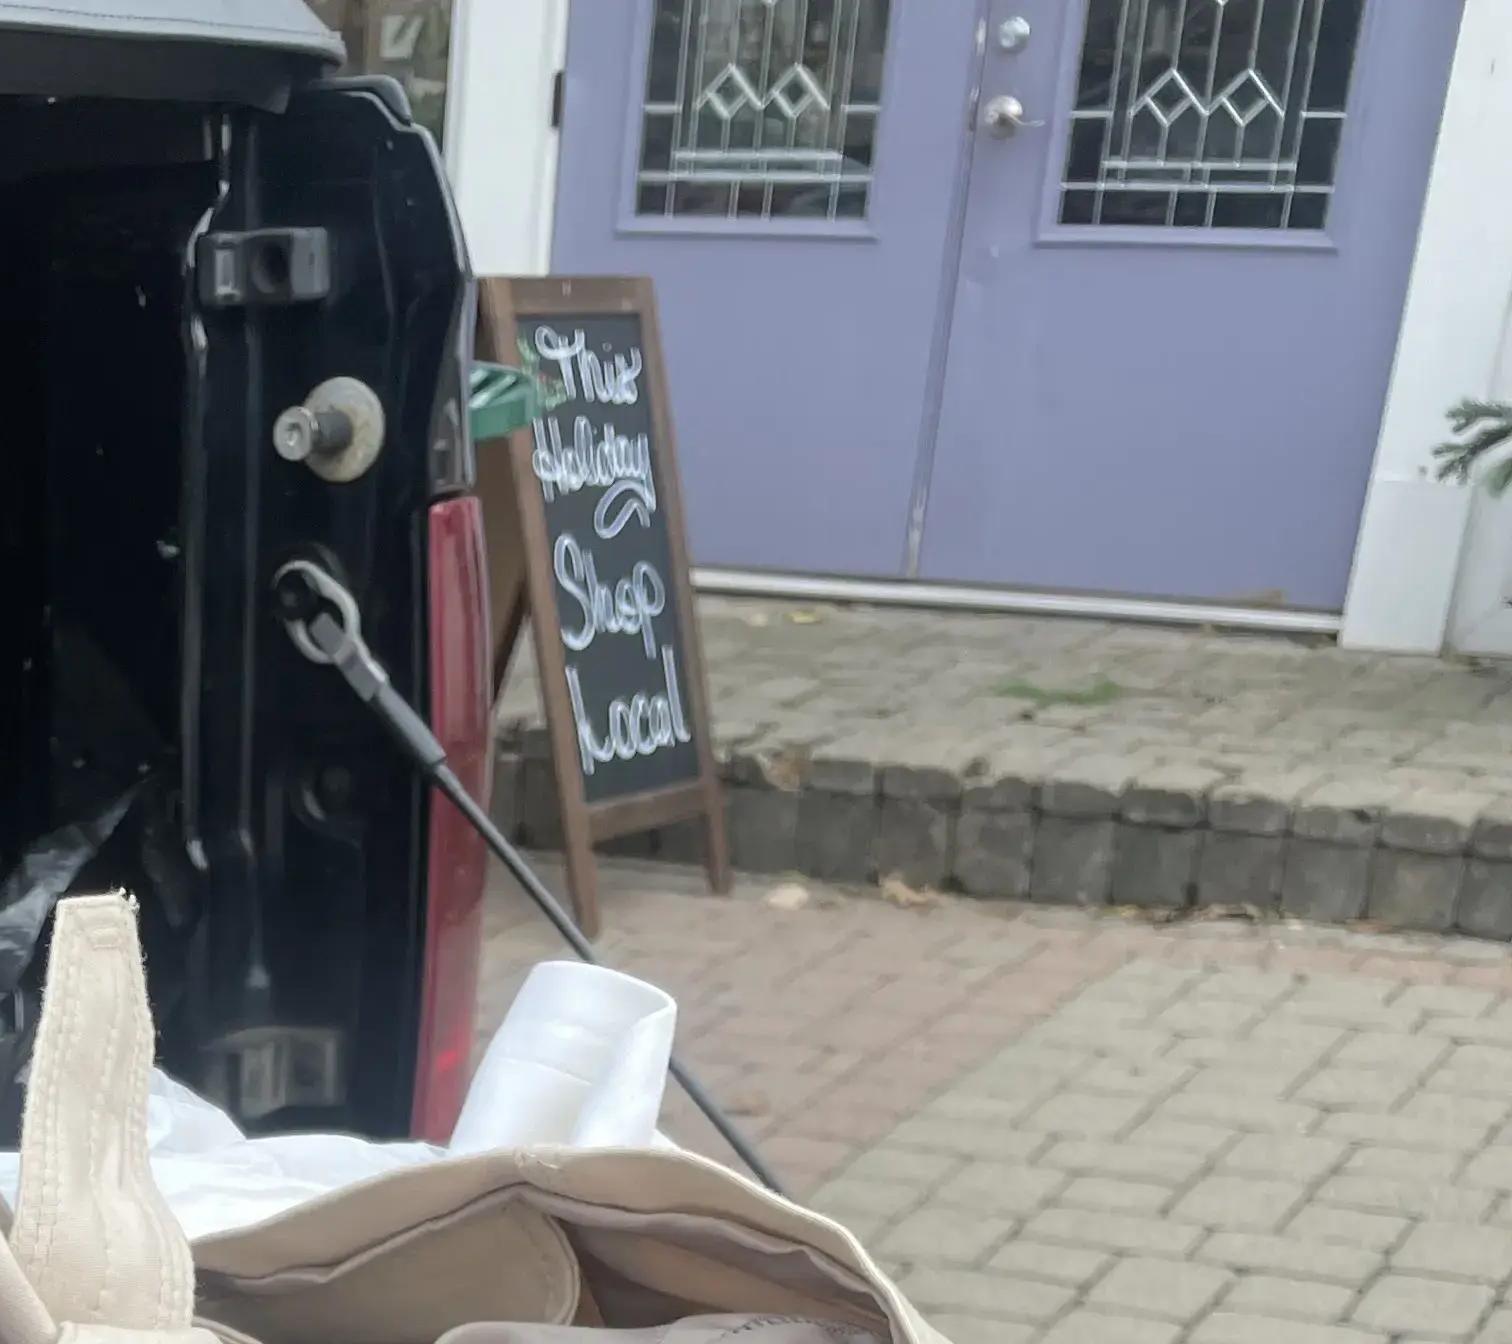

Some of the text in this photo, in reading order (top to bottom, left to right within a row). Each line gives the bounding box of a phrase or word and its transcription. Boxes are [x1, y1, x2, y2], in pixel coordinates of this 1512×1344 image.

[535, 324, 642, 404] This
[532, 415, 656, 539] Holiday
[554, 533, 665, 660] Shop
[565, 645, 691, 775] Local
